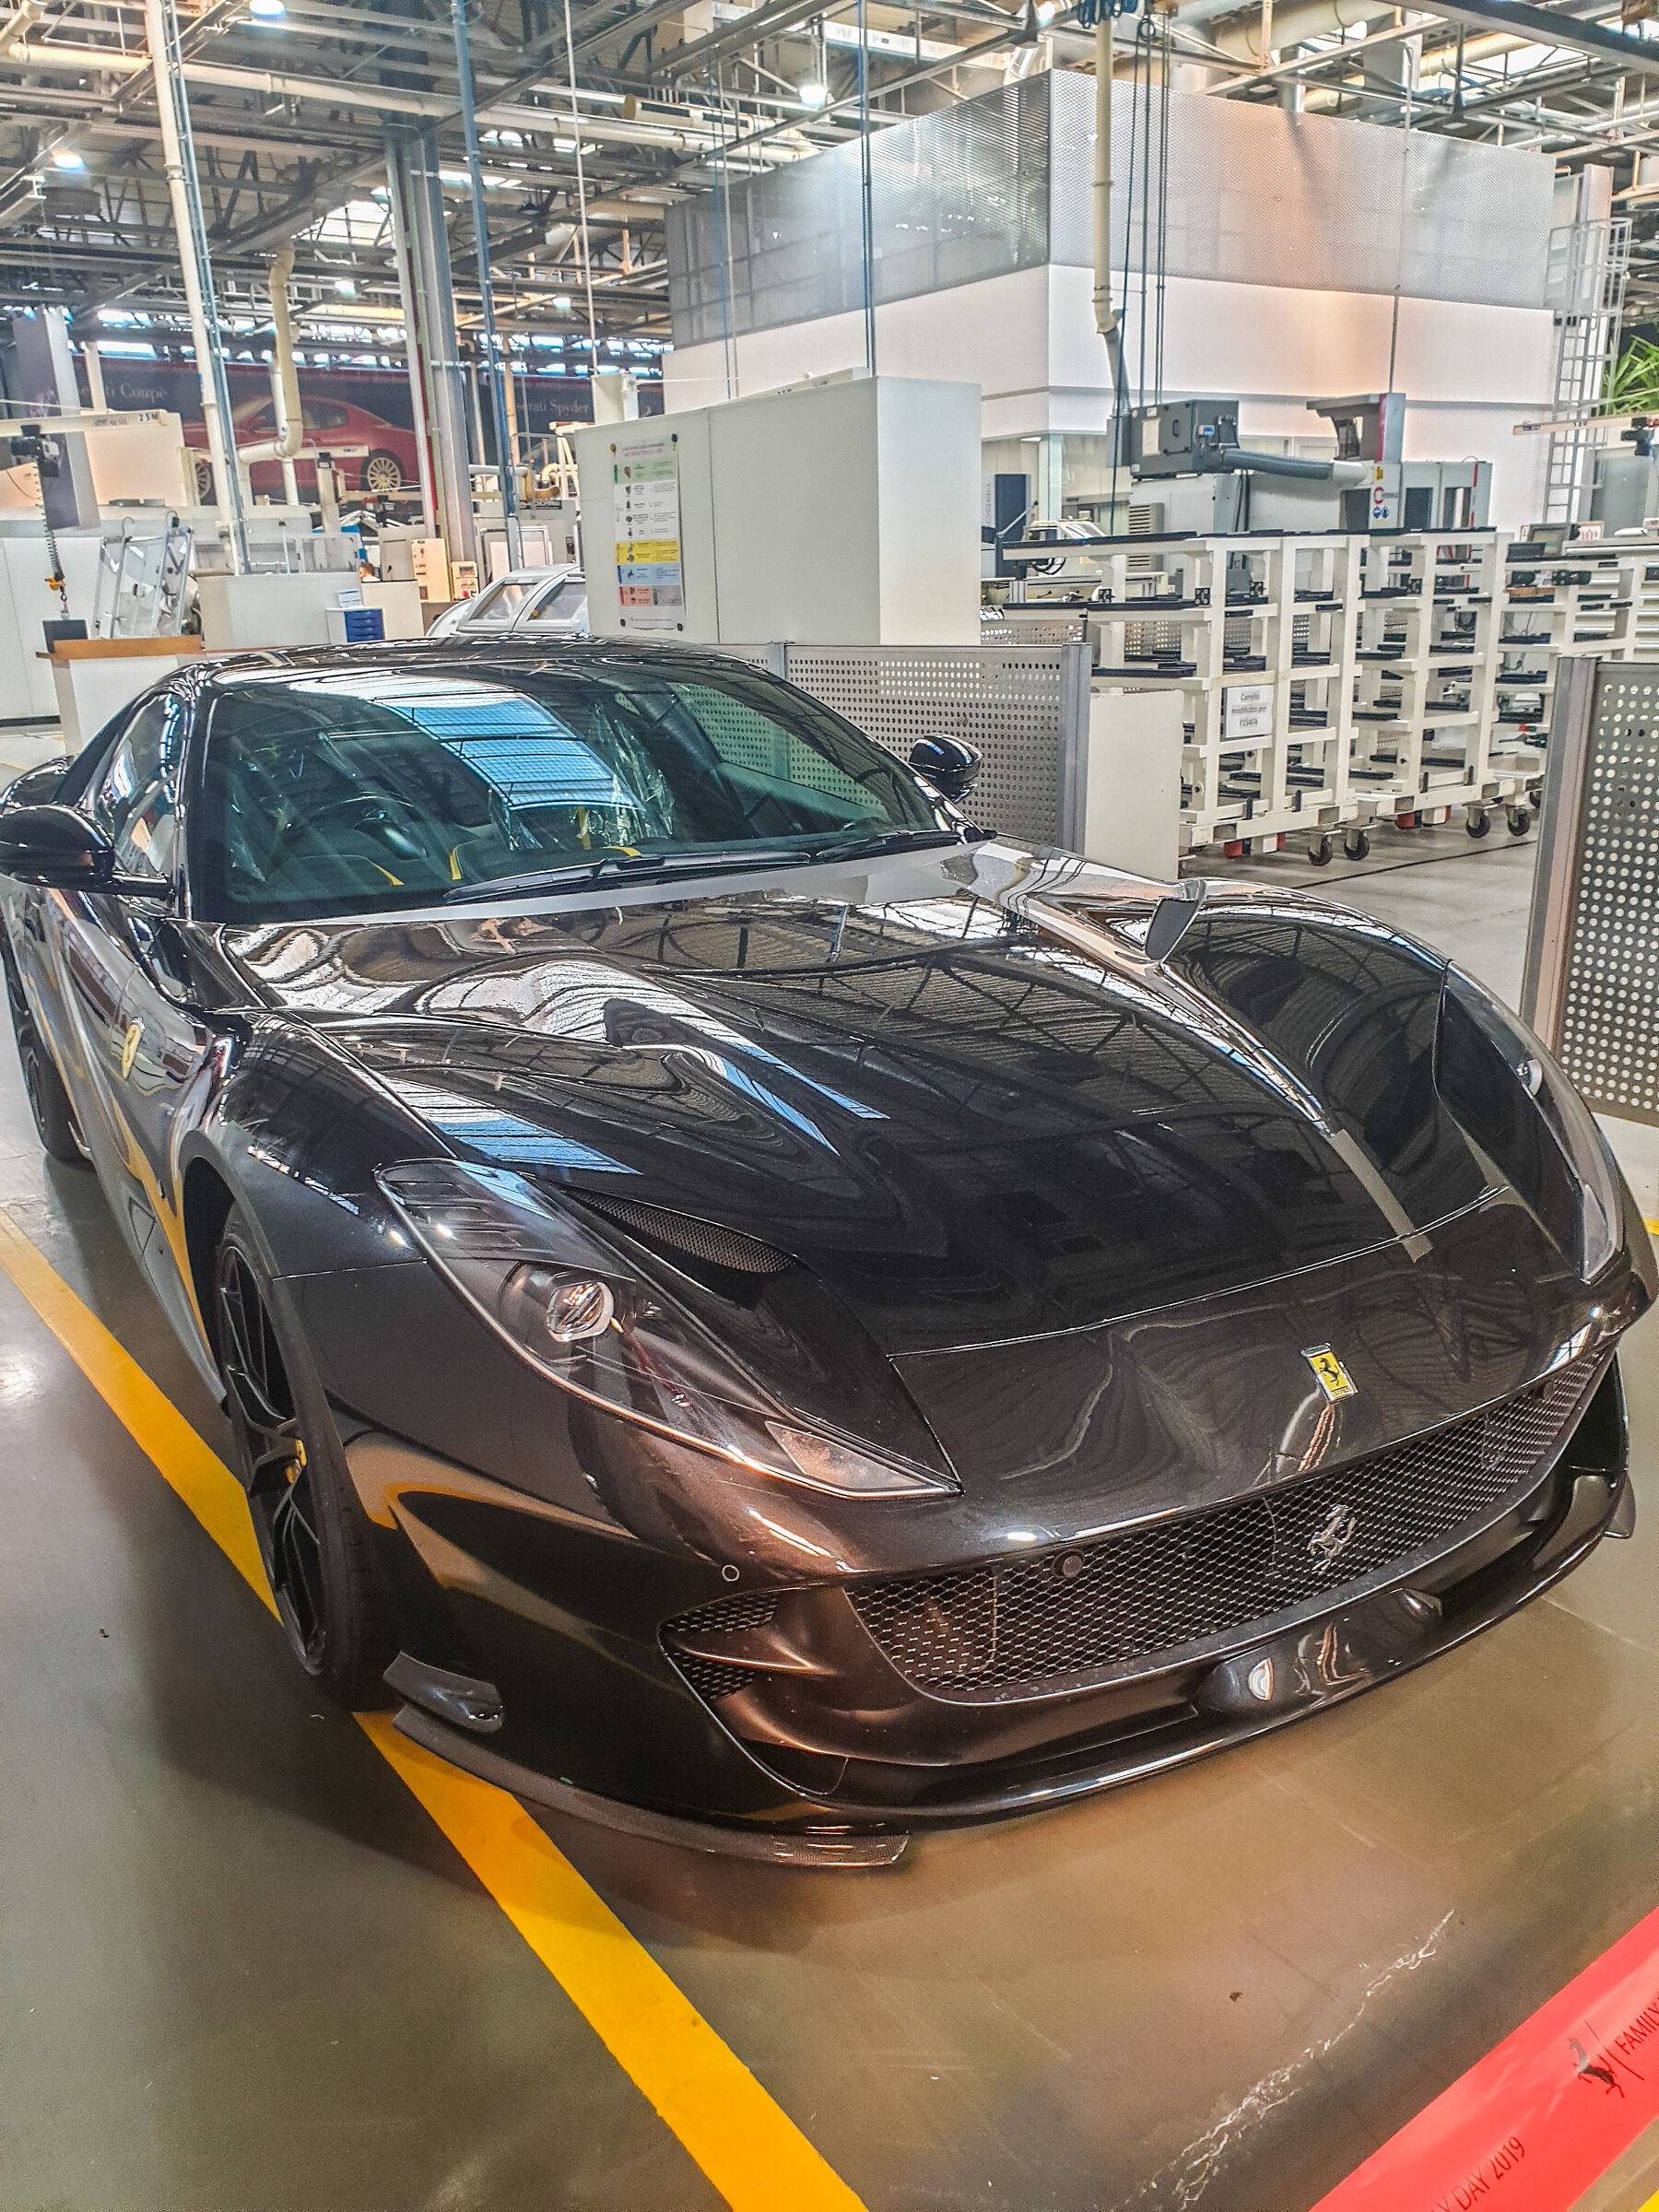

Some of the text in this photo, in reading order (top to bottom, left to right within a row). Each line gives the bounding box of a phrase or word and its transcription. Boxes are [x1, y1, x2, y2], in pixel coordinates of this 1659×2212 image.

[549, 399, 589, 417] Spyder
[1452, 2136, 1525, 2211] DAY 2019
